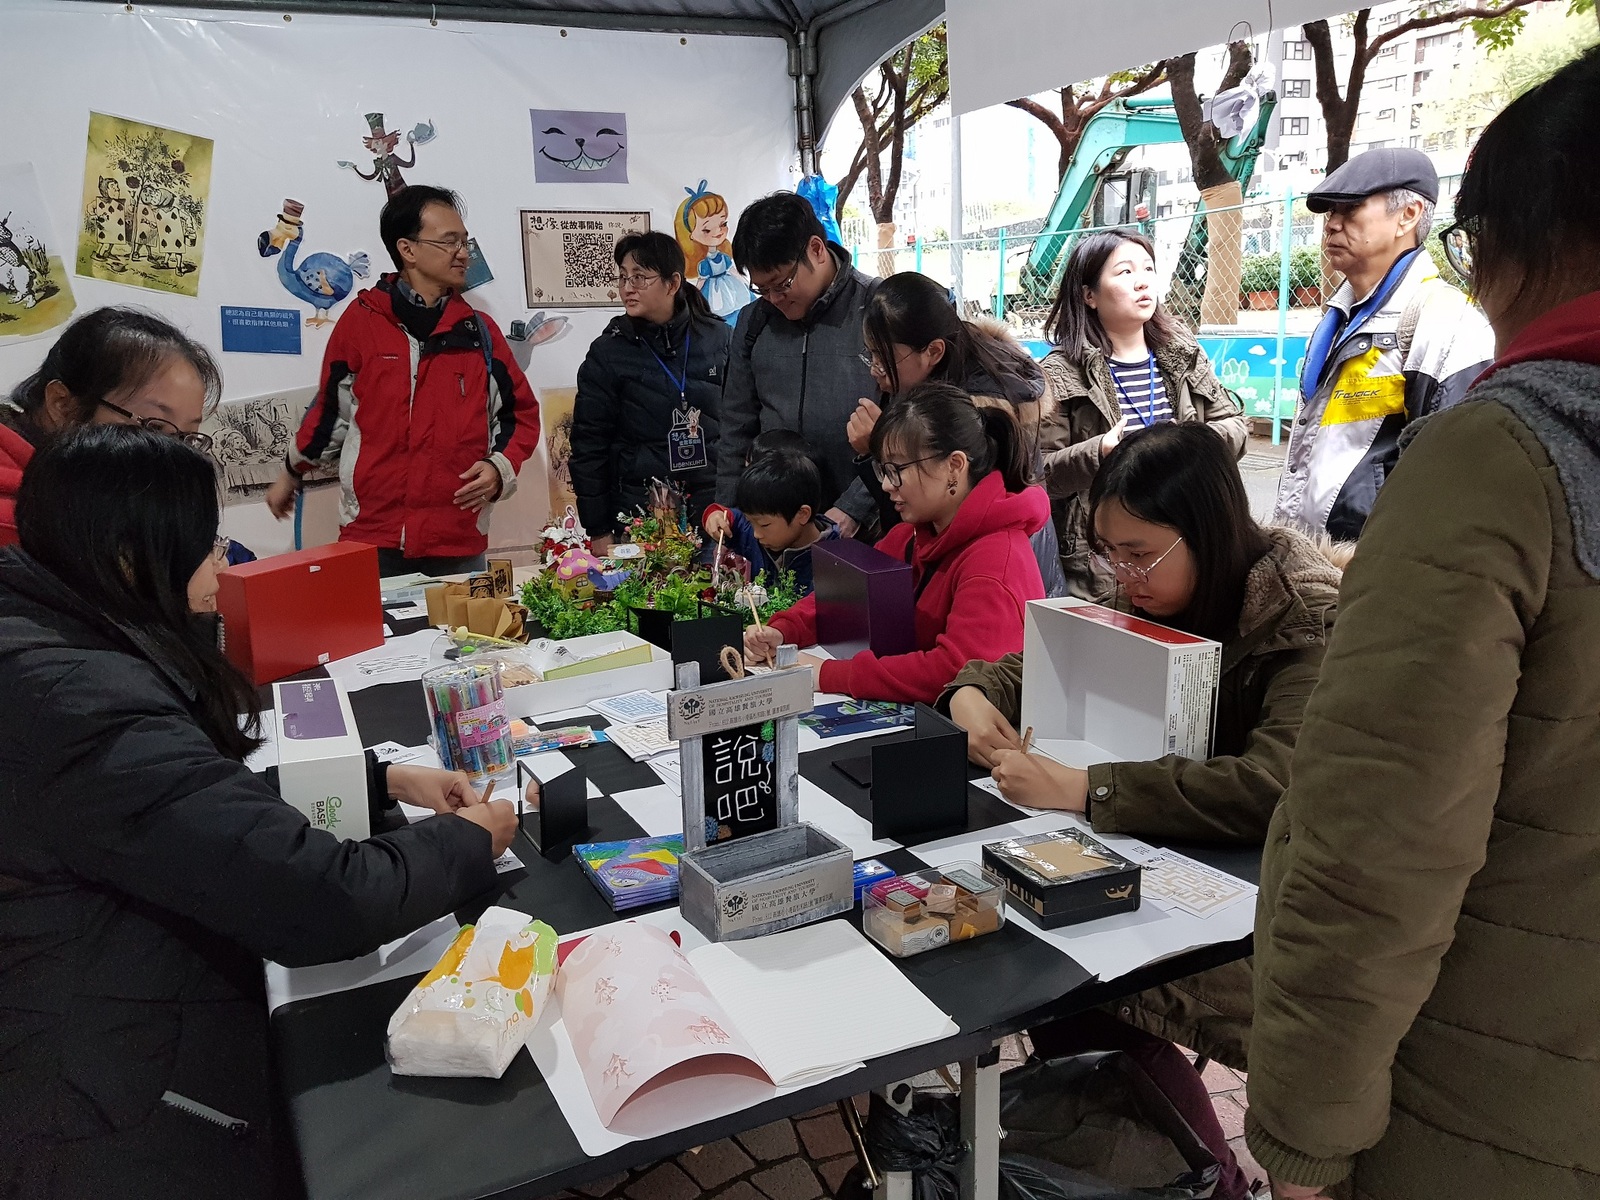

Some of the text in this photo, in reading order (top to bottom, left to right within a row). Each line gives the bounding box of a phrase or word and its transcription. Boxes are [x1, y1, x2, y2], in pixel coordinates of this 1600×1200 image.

[708, 697, 773, 717] 國立高雄餐旅大學
[316, 800, 327, 826] BASE
[751, 887, 816, 912] 國立高雄餐旅大學
